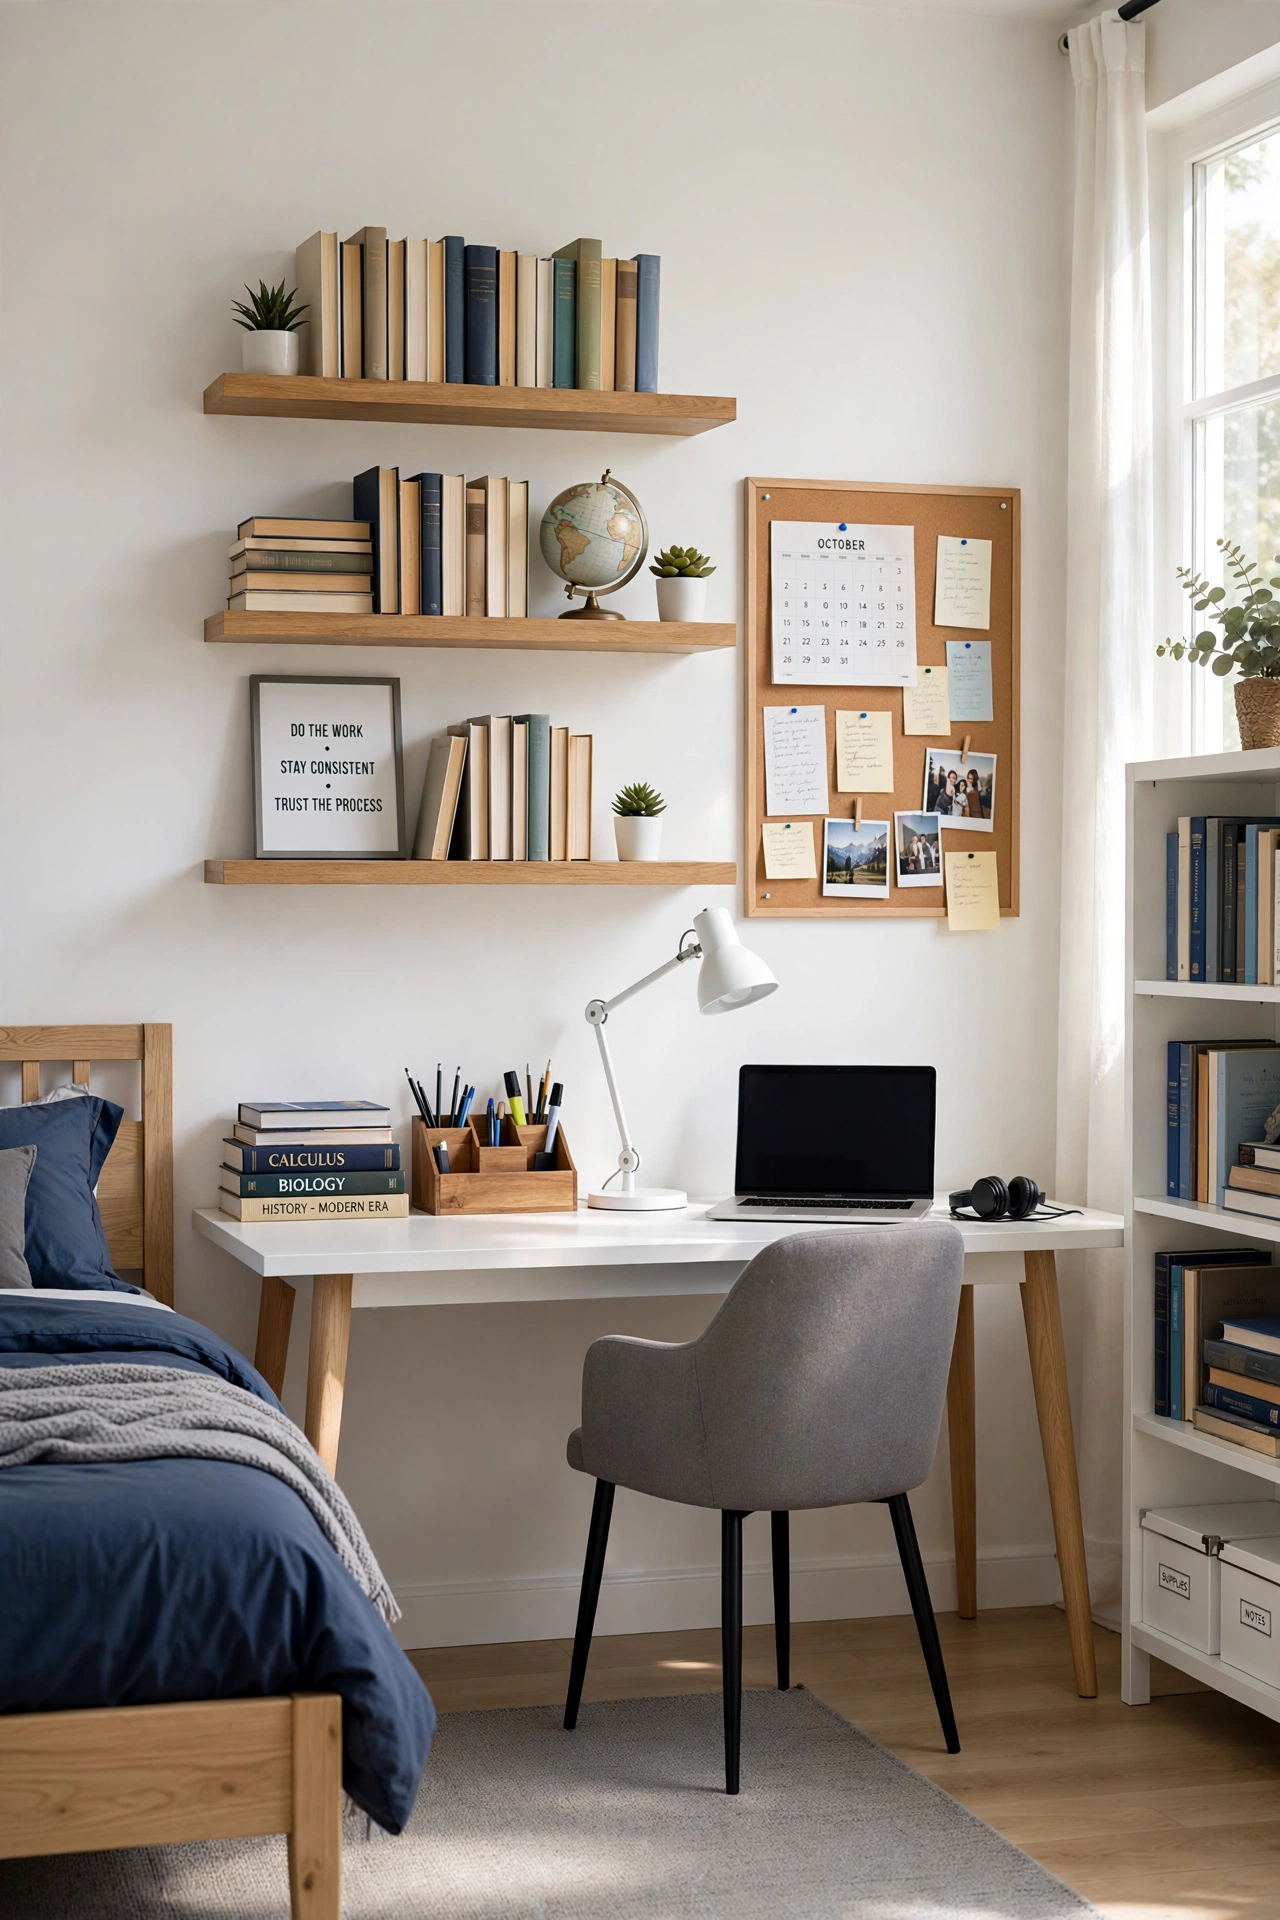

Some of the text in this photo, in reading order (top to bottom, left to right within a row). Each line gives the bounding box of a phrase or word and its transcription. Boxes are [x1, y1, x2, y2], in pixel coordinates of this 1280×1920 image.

[817, 538, 865, 551] OCTOBER
[784, 582, 789, 590] 2
[841, 583, 846, 591] 6
[860, 584, 865, 592] 7
[839, 602, 848, 610] 10
[896, 603, 904, 611] 15
[802, 619, 810, 627] 15
[821, 620, 830, 628] 16
[840, 620, 848, 628] 17
[877, 621, 885, 629] 21
[895, 621, 904, 629] 22
[782, 637, 791, 645] 21
[802, 637, 811, 646] 22
[821, 638, 830, 646] 23
[858, 639, 868, 647] 24
[877, 639, 886, 647] 25
[802, 656, 811, 664] 29
[821, 656, 831, 664] 30
[290, 723, 364, 738] DO THE WORK
[280, 759, 375, 775] STAY CONSISTENT
[274, 797, 383, 813] TRUST THE PROCESS
[268, 1152, 345, 1167] CALCULUS
[278, 1177, 346, 1192] BIOLOGY
[262, 1202, 308, 1215] HISTORY
[318, 1201, 365, 1214] MODERN
[368, 1200, 389, 1212] ERA
[1245, 1608, 1266, 1626] NOTES
